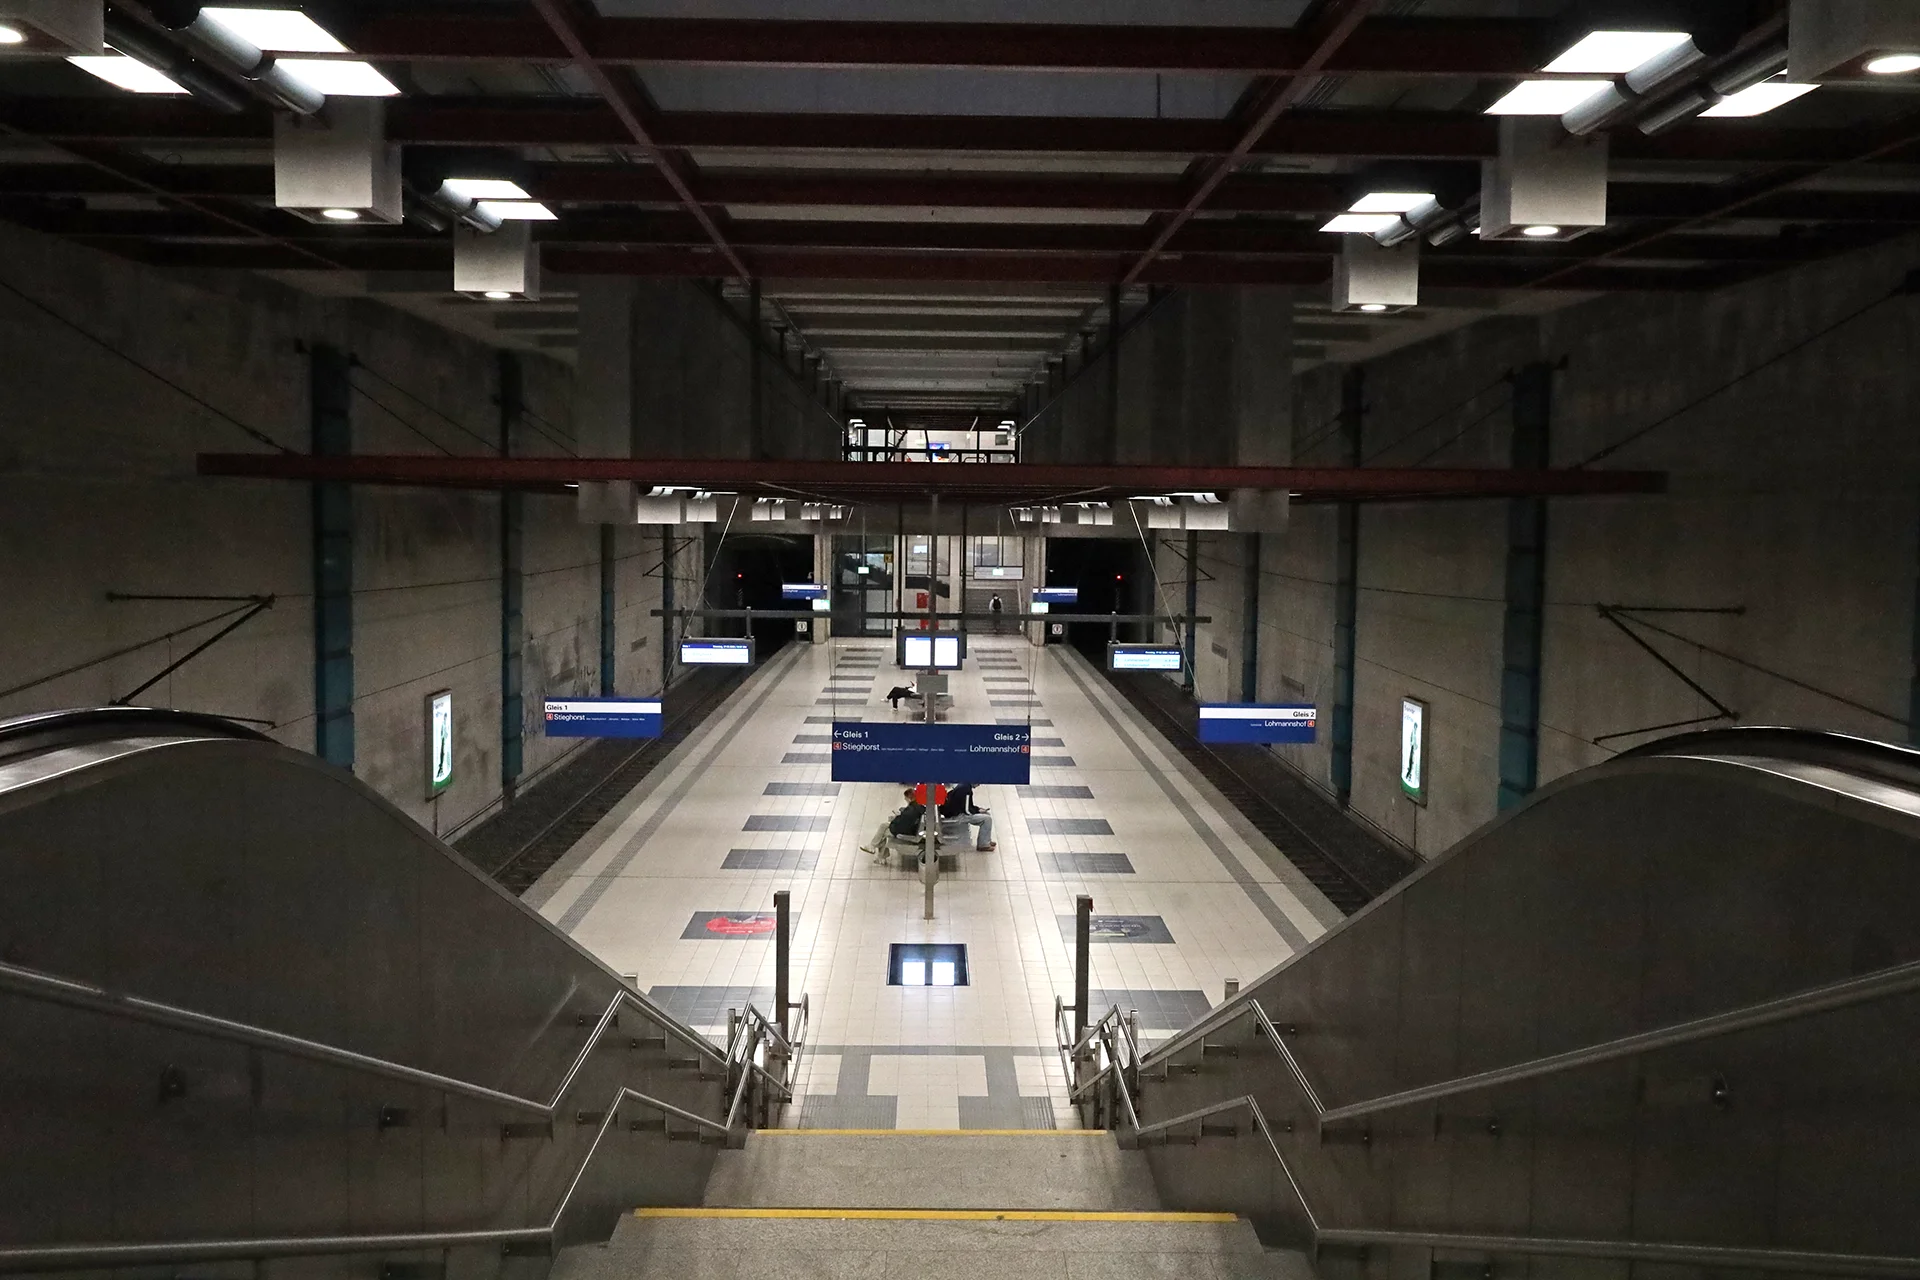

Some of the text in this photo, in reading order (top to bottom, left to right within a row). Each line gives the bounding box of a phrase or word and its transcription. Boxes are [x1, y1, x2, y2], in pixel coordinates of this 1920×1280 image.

[554, 713, 585, 721] Stieghorst
[843, 730, 869, 739] Gleis 1
[994, 733, 1020, 741] Gleis 2
[843, 742, 880, 752] Stieghorst
[970, 744, 1020, 753] Lohmannshof
